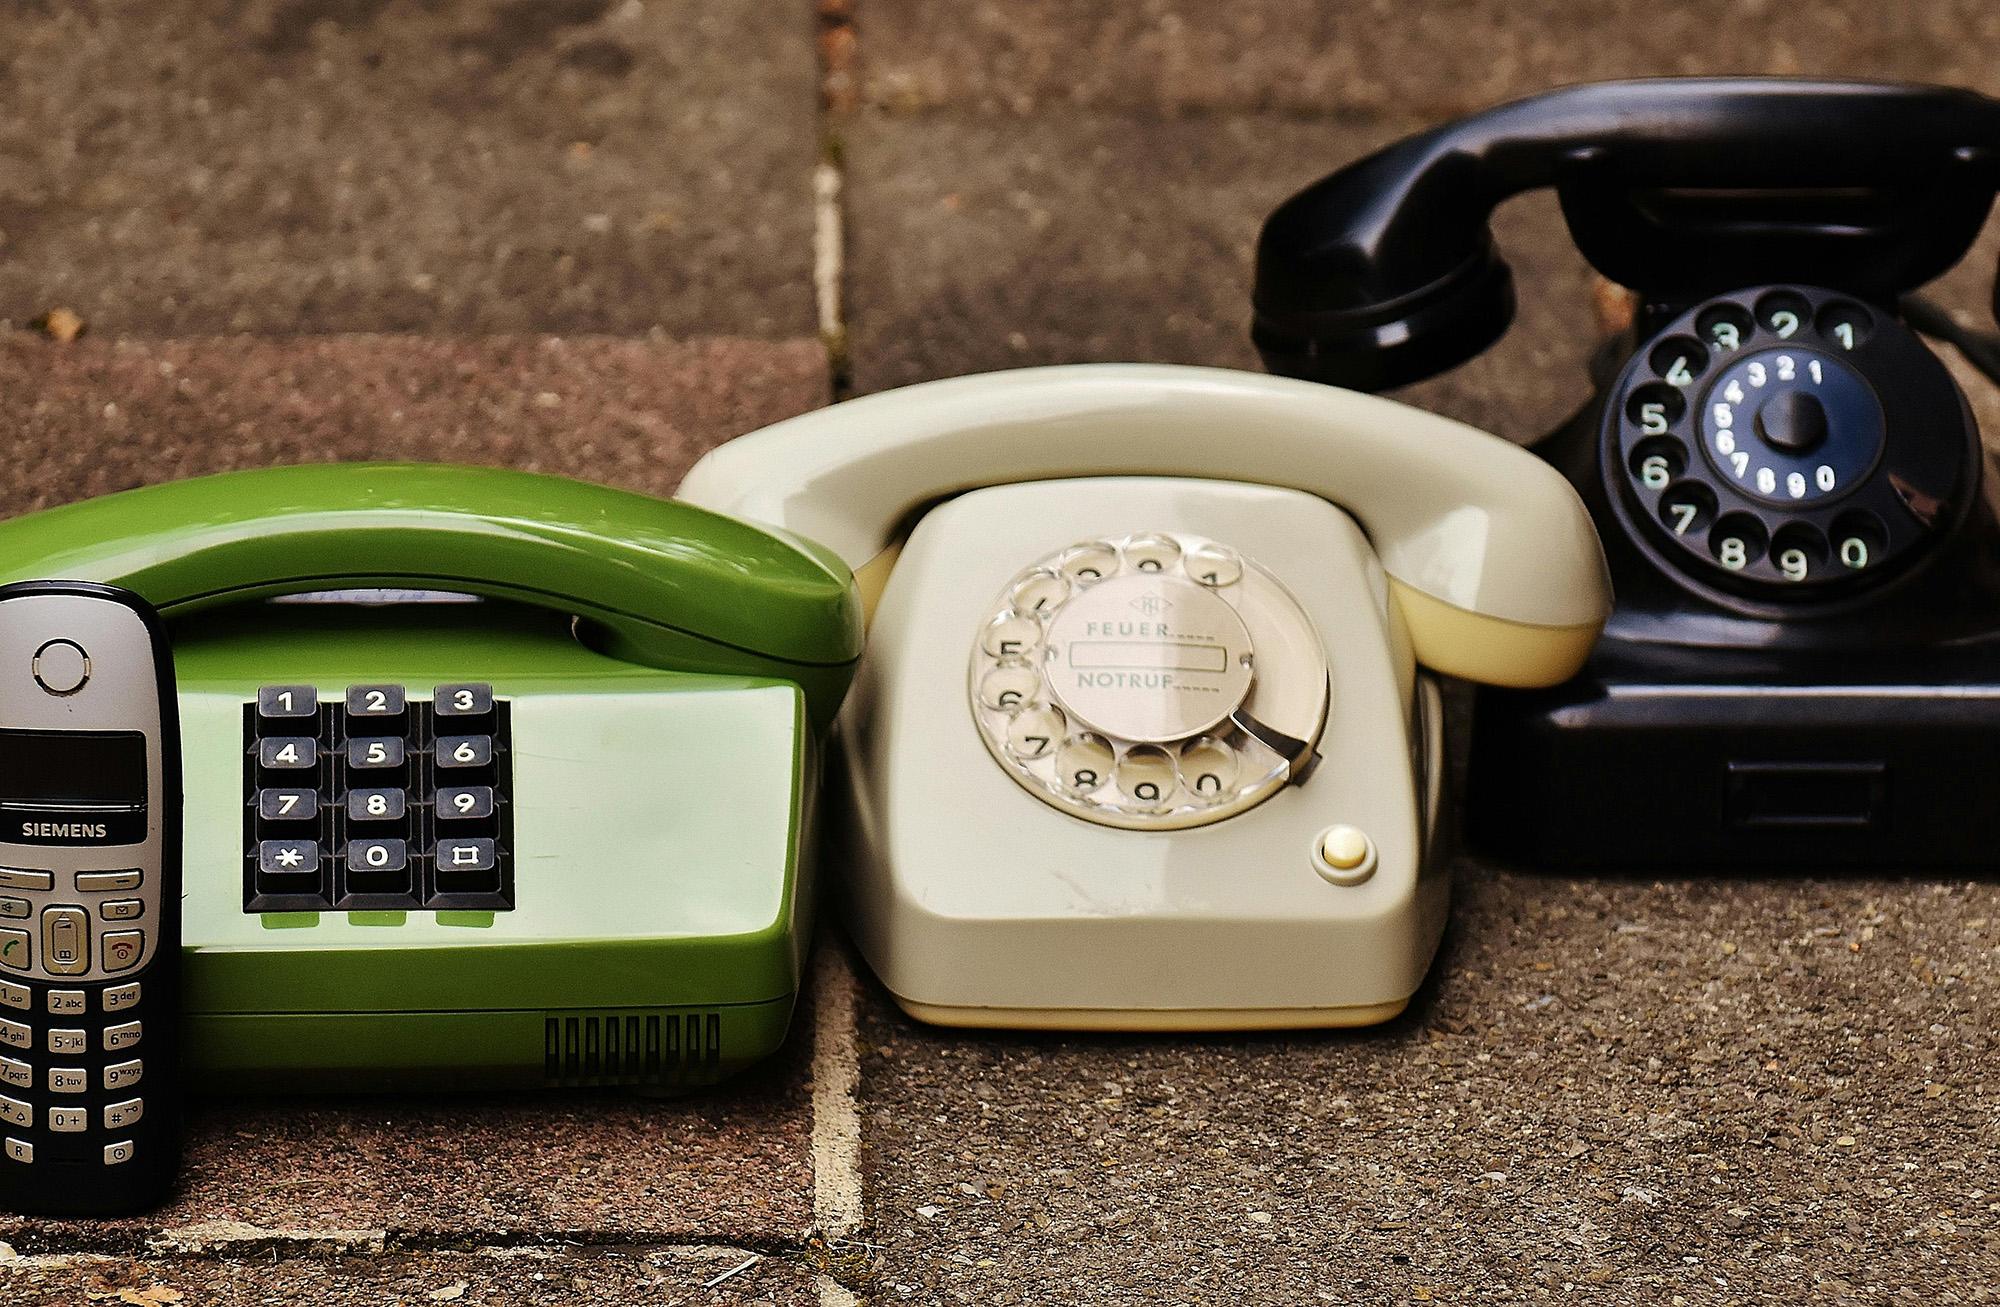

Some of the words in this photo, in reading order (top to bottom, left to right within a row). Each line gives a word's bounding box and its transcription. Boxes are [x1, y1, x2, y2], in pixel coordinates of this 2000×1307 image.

[1712, 322, 1740, 351] 3
[1834, 322, 1853, 350] 1
[1665, 356, 1693, 386] 4
[1748, 362, 1767, 388] 3
[1775, 355, 1796, 381] 2
[1808, 359, 1823, 385] 1
[1724, 379, 1744, 405] 4
[1641, 403, 1668, 436] 5
[1713, 403, 1733, 428] 5
[1715, 429, 1735, 455] 6
[1642, 455, 1670, 489] 6
[1730, 451, 1749, 479] 7
[1757, 467, 1776, 495] 8
[1787, 472, 1806, 499] 9
[1816, 465, 1835, 492] 0
[1671, 503, 1698, 536] 7
[1720, 536, 1747, 571] 8
[1841, 537, 1868, 569] 0
[1780, 549, 1807, 582] 9
[1087, 622, 1169, 637] FEUER
[1078, 672, 1173, 690] NOTRUF
[278, 691, 293, 712] 1
[365, 690, 387, 712] 2
[453, 690, 474, 710] 3
[275, 743, 299, 764] 4
[366, 742, 387, 763] 5
[453, 742, 476, 762] 6
[278, 795, 300, 815] 7
[366, 795, 387, 815] 8
[453, 793, 476, 813] 9
[22, 822, 107, 838] SIEMENS
[365, 845, 389, 866] 0
[1, 988, 7, 999] 1
[53, 997, 62, 1008] 2
[65, 1000, 82, 1008] abc
[110, 993, 118, 1005] 3
[120, 991, 136, 1000] def
[0, 1026, 8, 1038] 4
[10, 1032, 25, 1042] ghi
[54, 1036, 62, 1048] 5
[71, 1037, 83, 1048] jkl
[110, 1033, 119, 1045] 6
[1, 1064, 9, 1075] 7
[9, 1071, 28, 1080] pqrs
[55, 1075, 63, 1087] 8
[67, 1078, 82, 1086] tuv
[110, 1071, 119, 1083] 9
[120, 1068, 141, 1076] wxyz
[56, 1114, 64, 1125] 0
[112, 1113, 122, 1123] #
[15, 1146, 23, 1156] R
